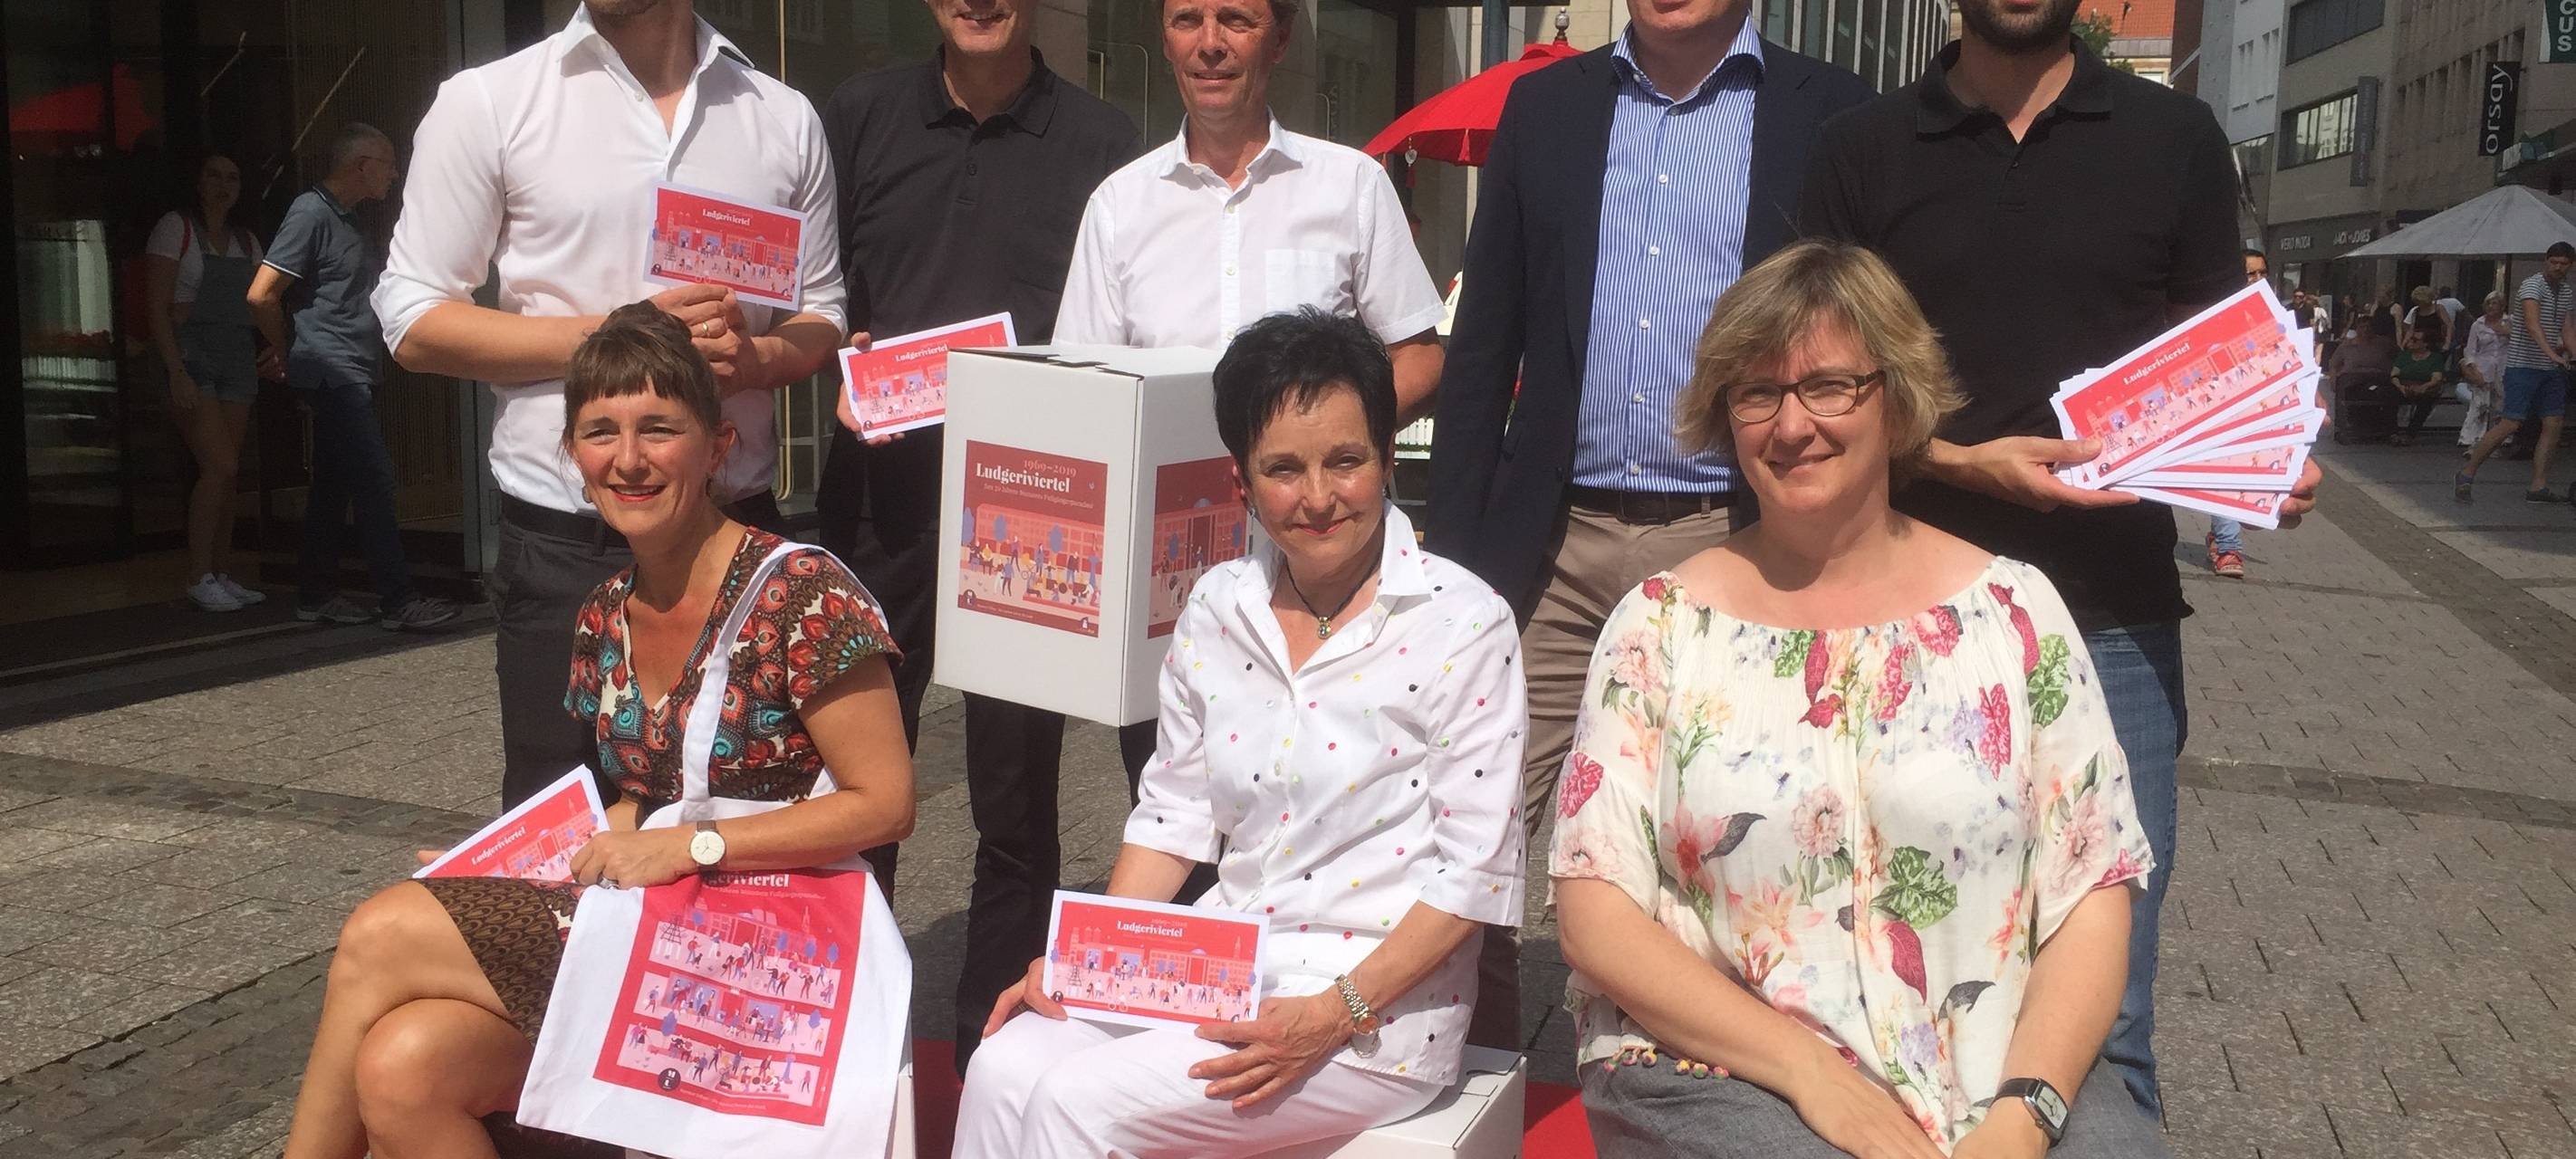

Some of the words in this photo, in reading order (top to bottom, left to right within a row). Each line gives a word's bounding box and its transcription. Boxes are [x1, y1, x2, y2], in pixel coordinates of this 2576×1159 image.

[2485, 63, 2513, 154] orsay
[895, 343, 948, 362] Ludgeriviertel
[2123, 342, 2190, 385] Ludgeriviertel
[976, 463, 1070, 493] Ludgeriviertel
[472, 826, 525, 865] Ludgeriviertel
[1117, 920, 1184, 937] Ludgeriviertel
